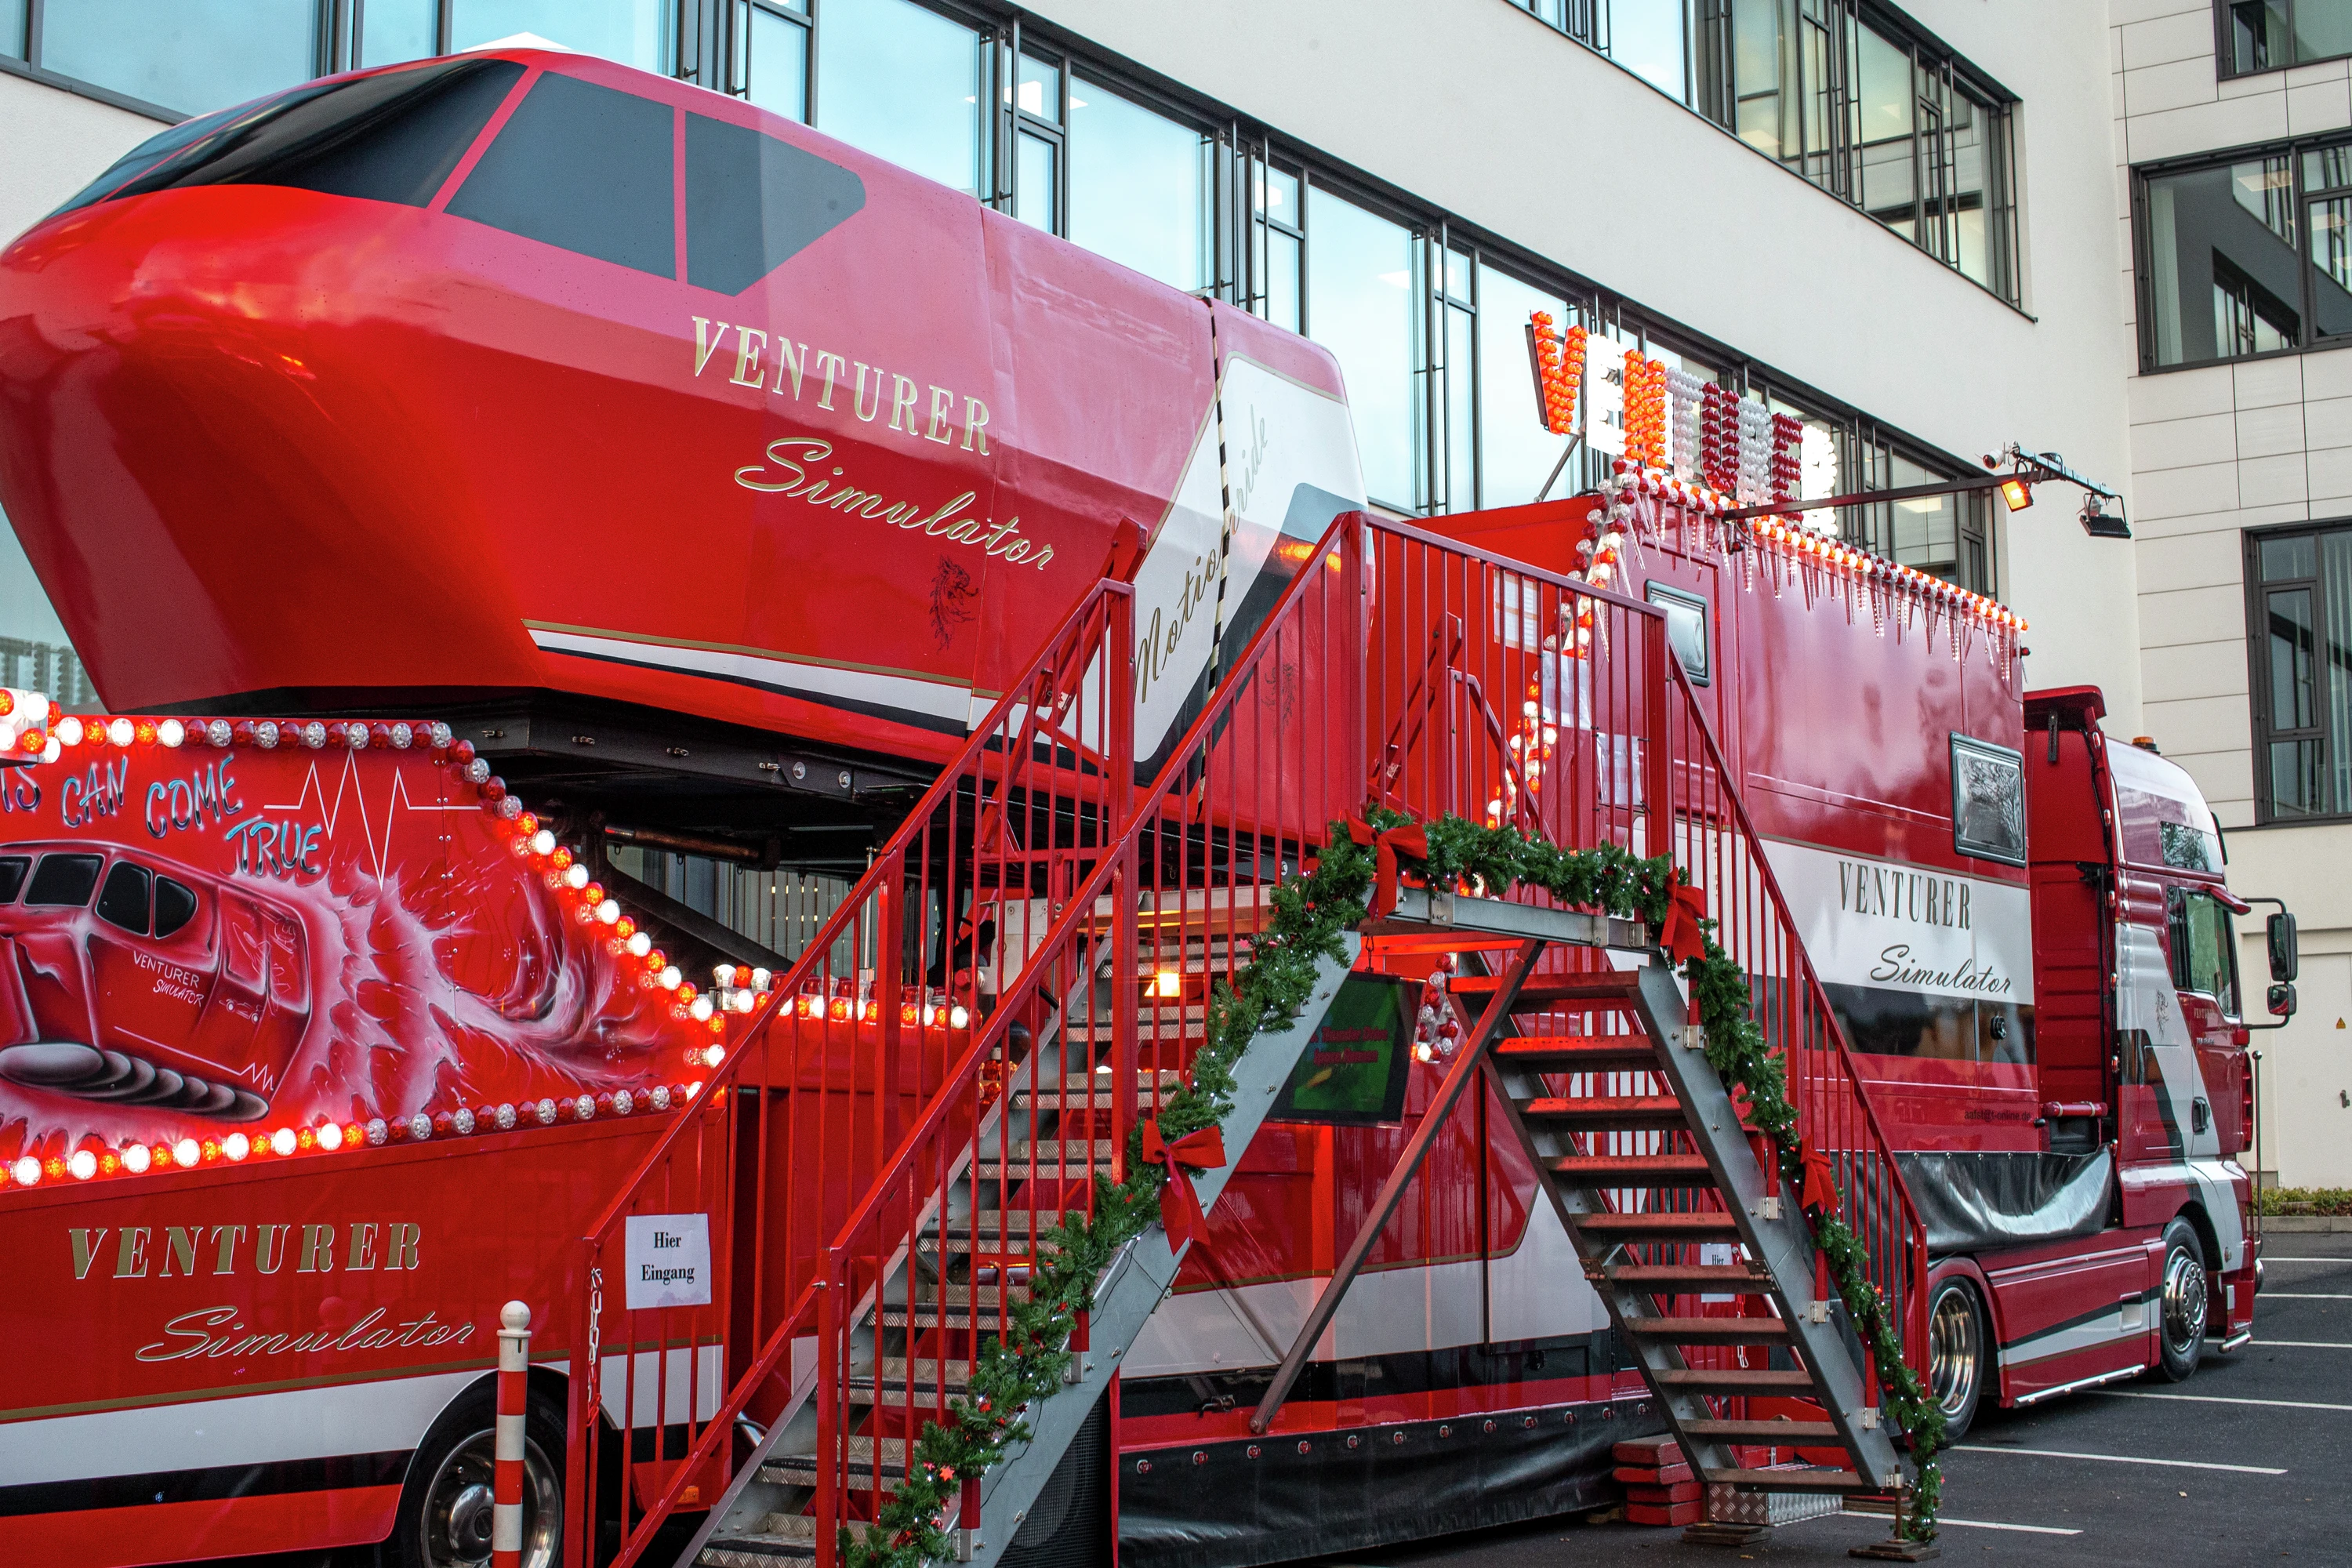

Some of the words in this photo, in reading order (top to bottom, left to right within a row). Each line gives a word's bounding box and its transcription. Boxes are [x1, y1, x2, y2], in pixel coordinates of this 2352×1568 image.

[691, 315, 990, 456] VENTURER
[1530, 310, 1838, 536] VENTURER
[1236, 403, 1269, 513] ride
[734, 436, 1054, 571] Simulator
[60, 754, 128, 828] CAN
[145, 753, 243, 839] COME
[223, 815, 323, 876] TRUE
[1838, 861, 1971, 931] VENTURER
[133, 949, 200, 989] VENTURER
[1870, 943, 2012, 994] Simulator
[67, 1221, 421, 1279] VENTURER
[653, 1231, 682, 1249] Hier
[1711, 1254, 1724, 1265] Hier
[641, 1263, 695, 1286] Eingang
[134, 1305, 475, 1363] Simulator
